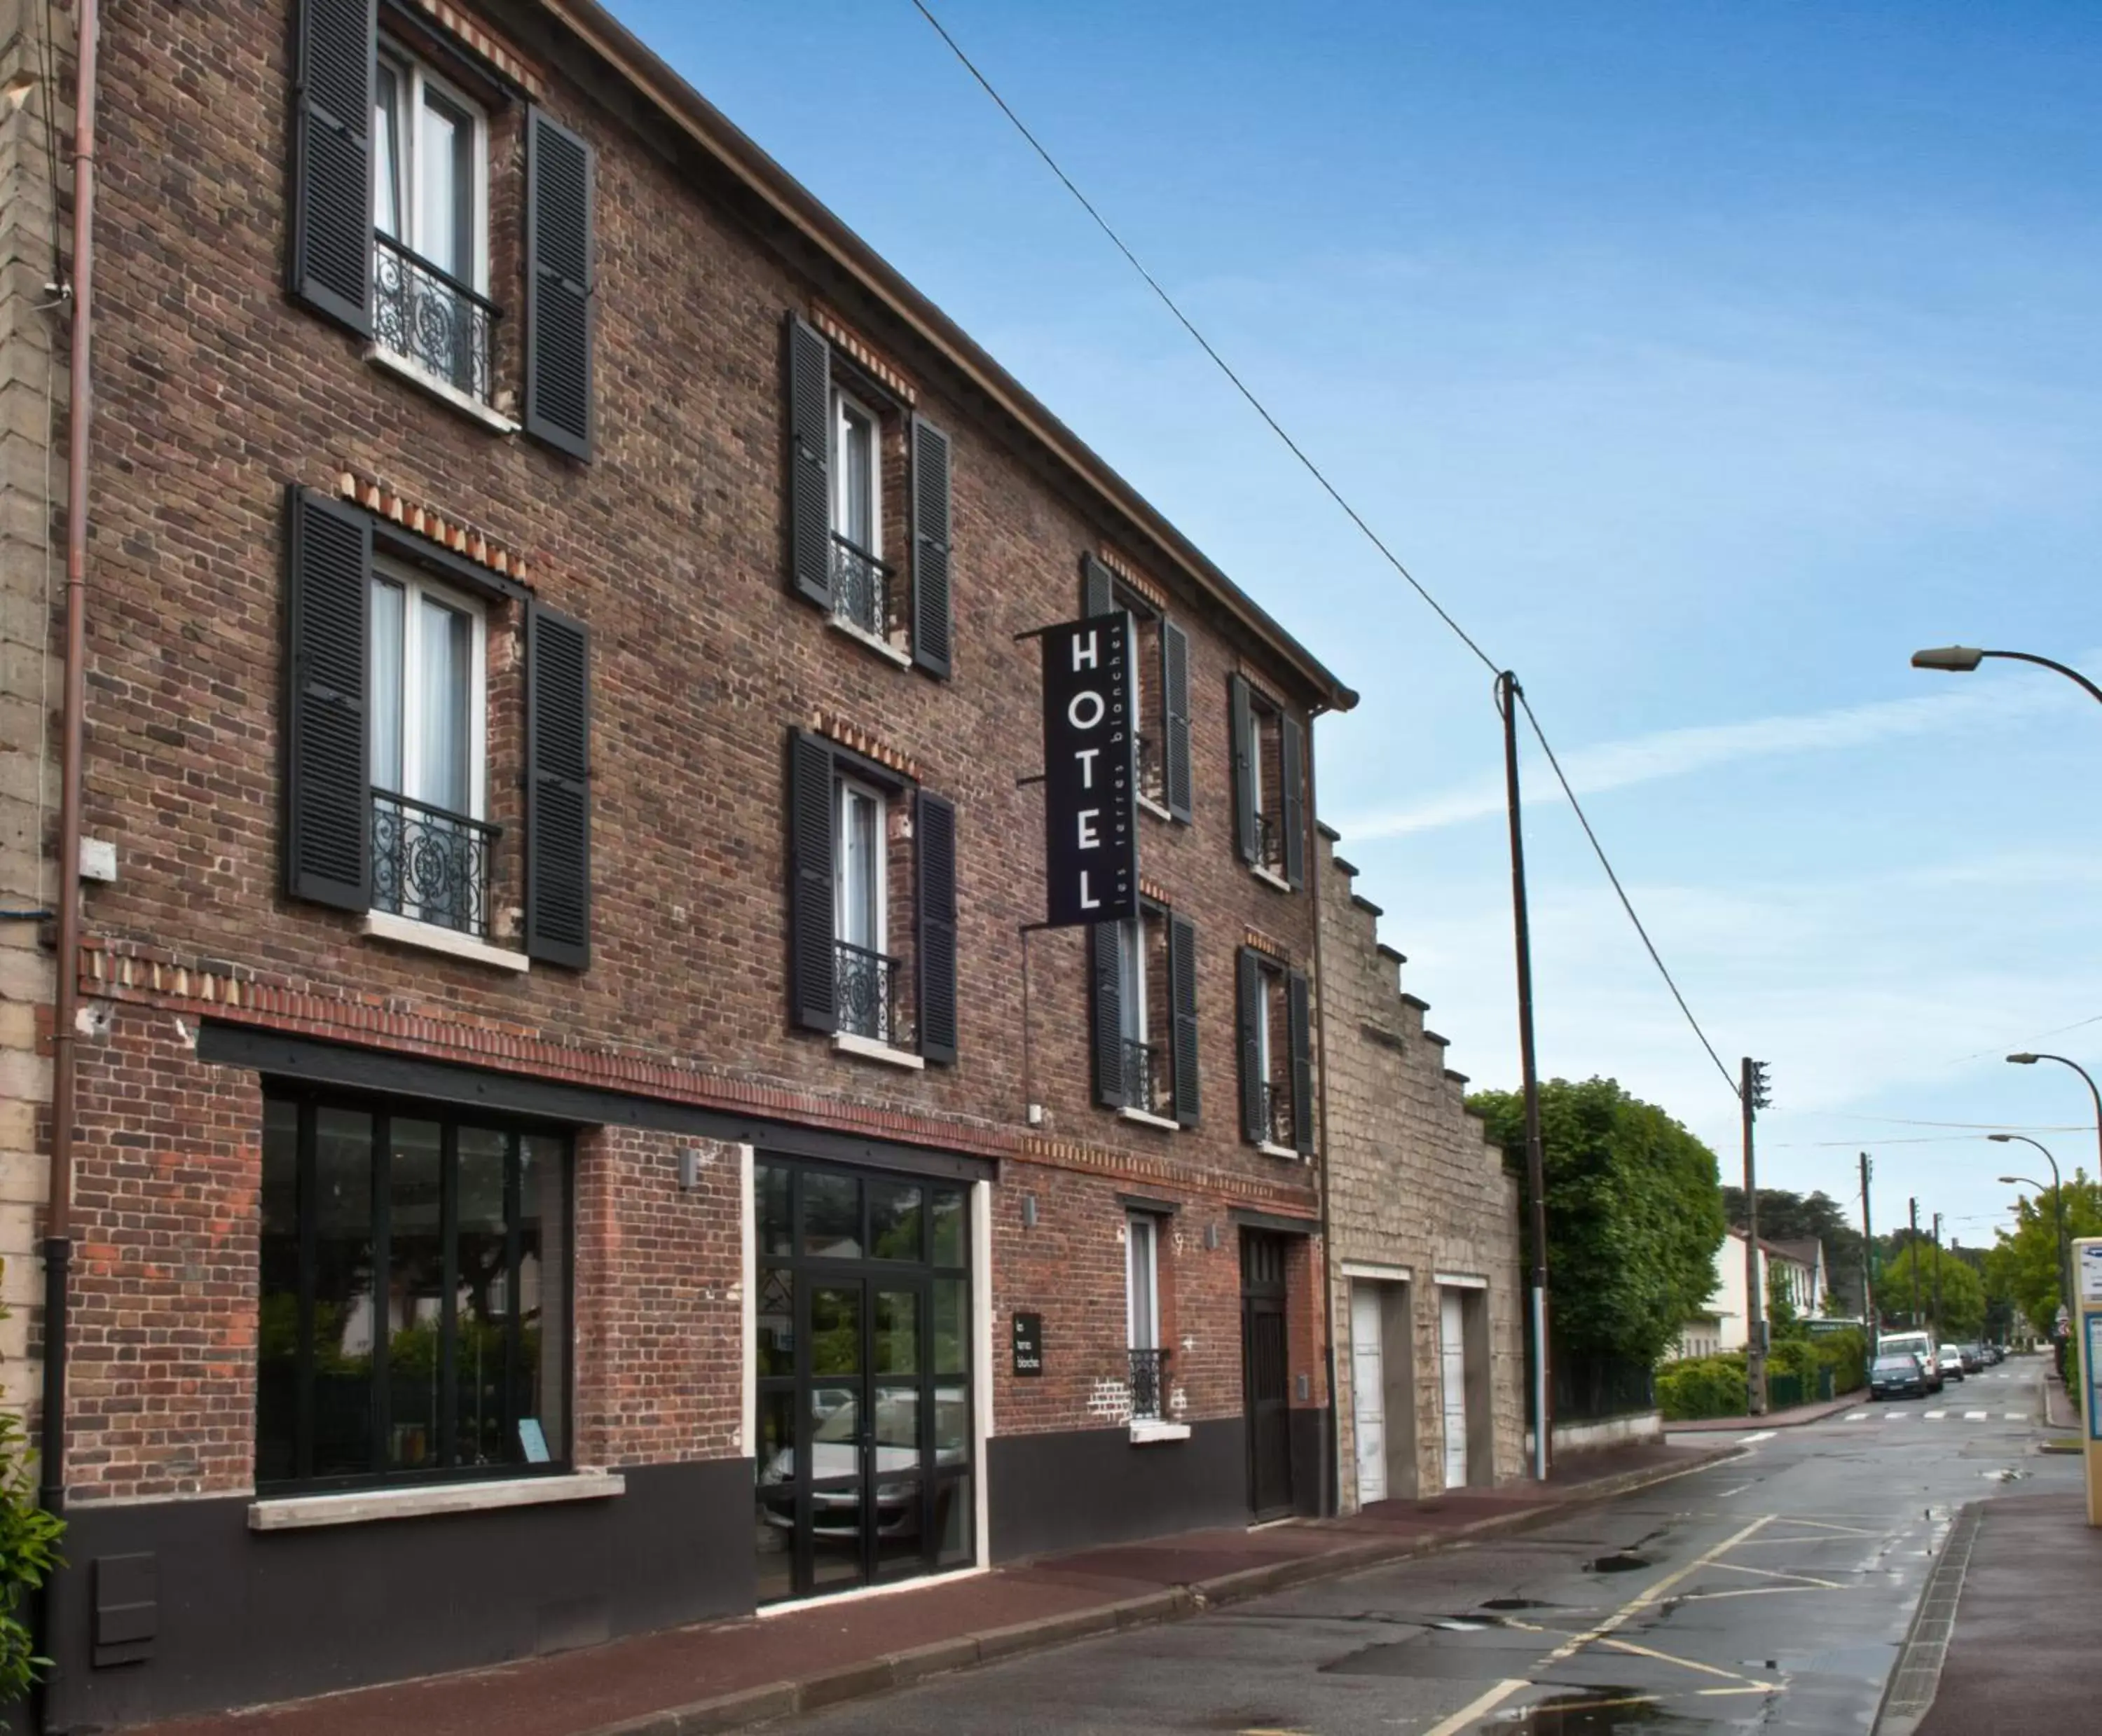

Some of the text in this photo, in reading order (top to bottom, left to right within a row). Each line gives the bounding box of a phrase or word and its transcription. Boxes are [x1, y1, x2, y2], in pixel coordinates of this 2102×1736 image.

[1109, 626, 1123, 743] blanches
[1068, 630, 1105, 909] HOTEL
[1113, 868, 1127, 904] les
